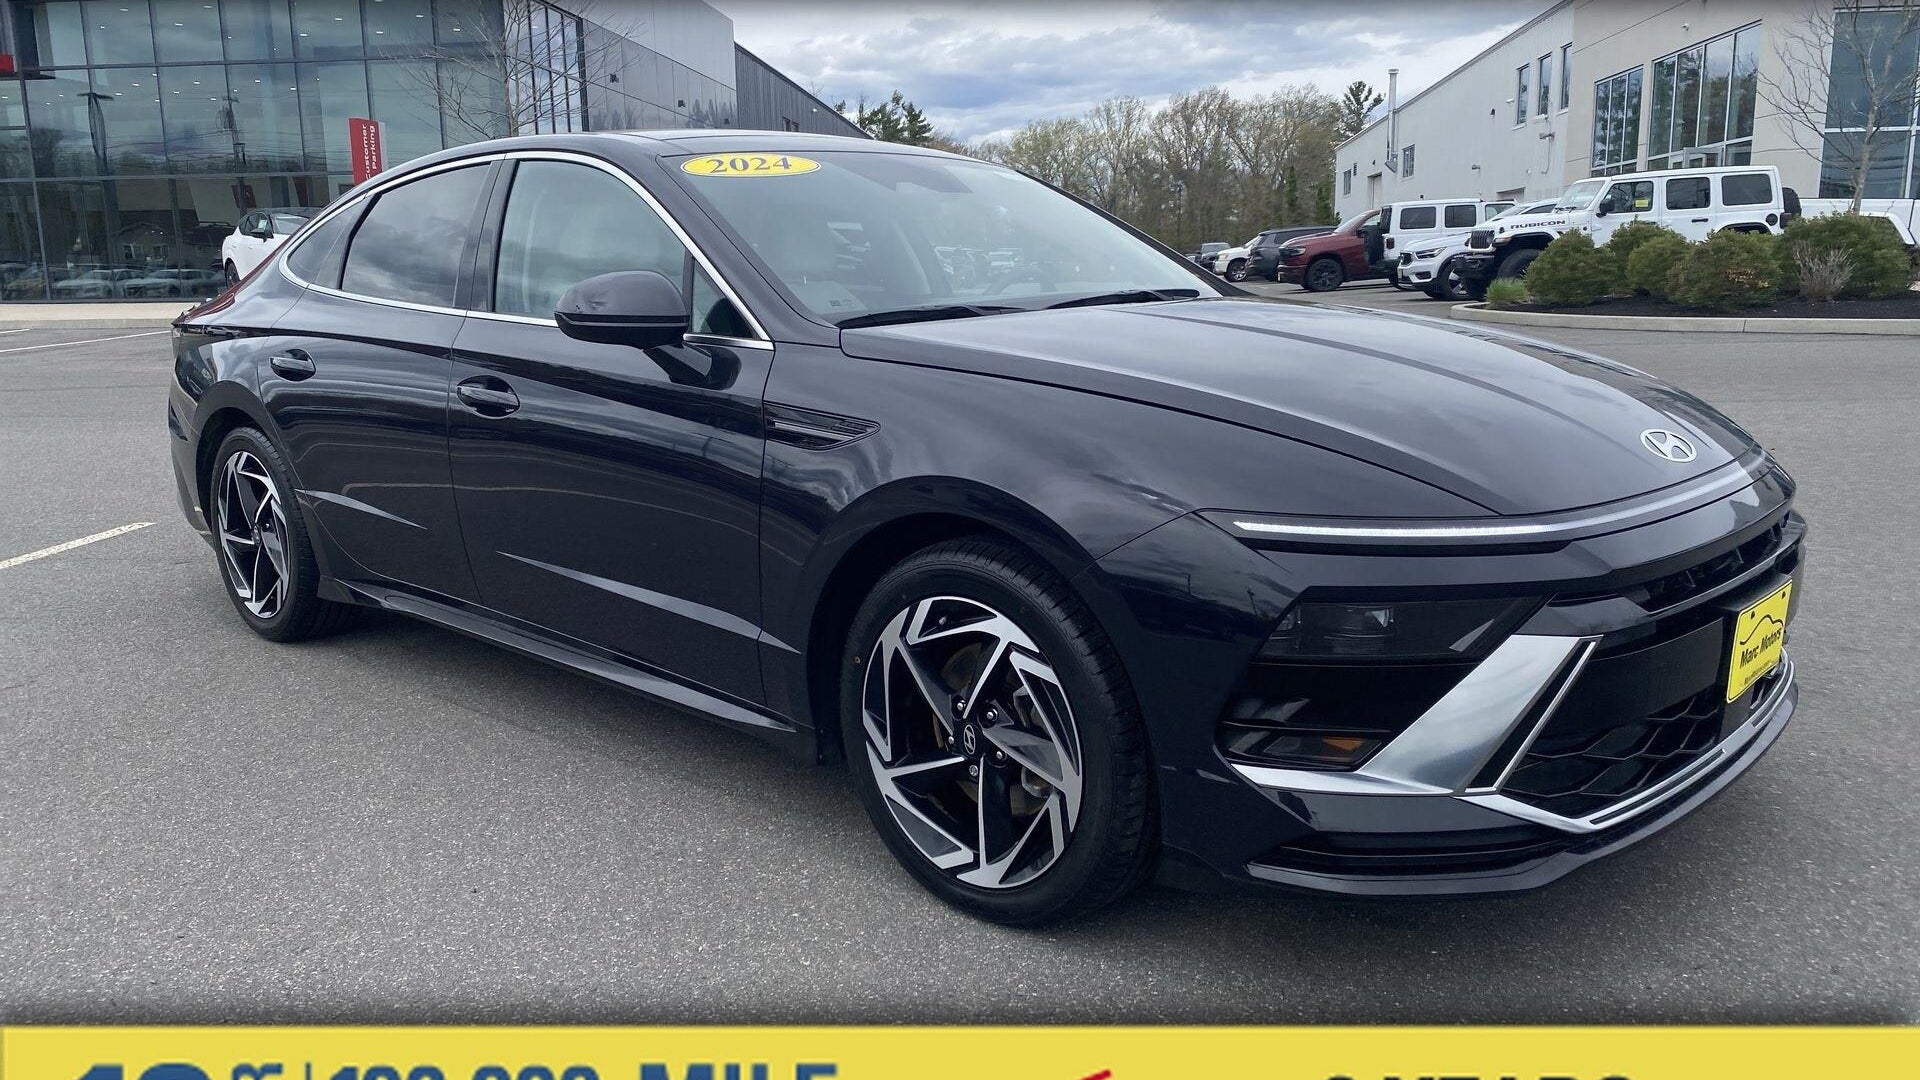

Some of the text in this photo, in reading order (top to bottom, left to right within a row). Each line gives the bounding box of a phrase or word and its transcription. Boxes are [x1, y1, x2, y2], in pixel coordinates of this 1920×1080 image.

[369, 125, 377, 170] Parking
[706, 157, 792, 174] 2024
[1510, 220, 1566, 230] RUBICON
[1739, 627, 1782, 669] Marc Motors
